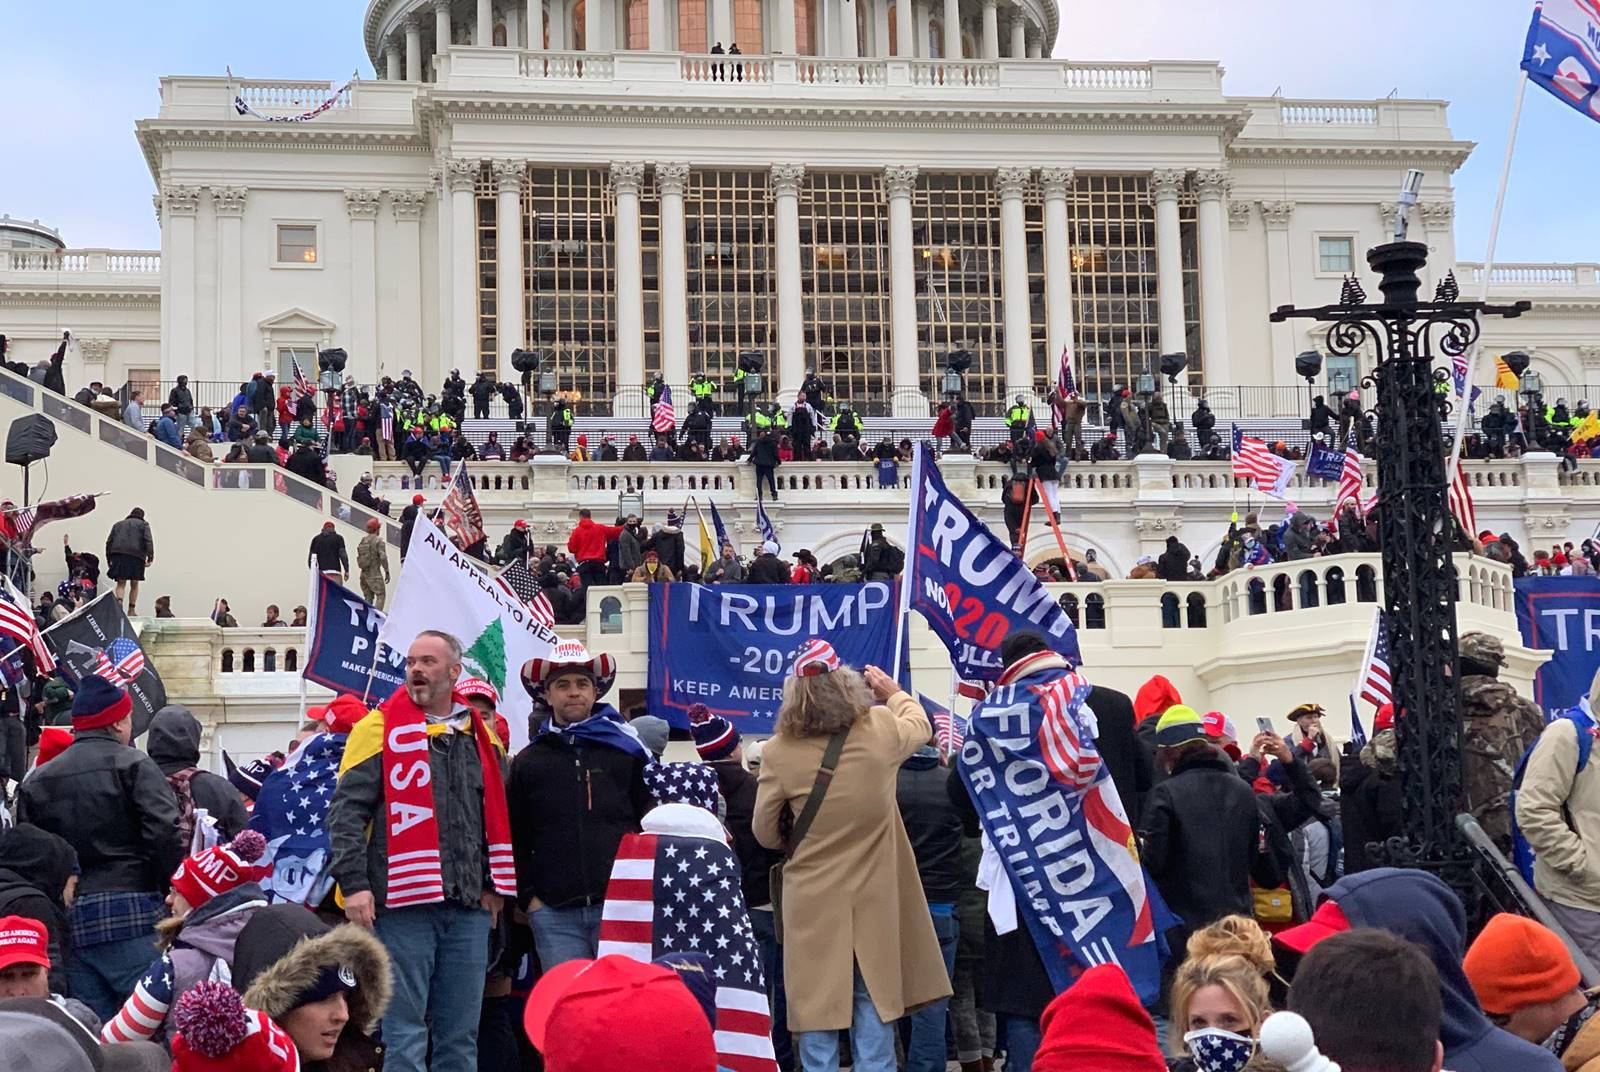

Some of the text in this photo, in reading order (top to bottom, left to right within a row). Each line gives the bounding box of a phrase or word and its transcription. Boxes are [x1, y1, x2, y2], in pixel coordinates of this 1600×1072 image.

[1319, 450, 1345, 462] TRU
[424, 532, 558, 646] AN APPEAL TO HEA
[687, 582, 890, 636] TRUMP
[86, 613, 107, 641] LIBERTY
[555, 643, 585, 654] TRUMP
[559, 650, 581, 658] 2020
[341, 660, 367, 674] MAKE
[673, 678, 783, 701] KEEP AMER
[388, 721, 434, 837] USA
[980, 702, 1113, 942] FLORIDA
[0, 937, 38, 946] REAT AGAIN
[10, 929, 40, 938] AMERICA
